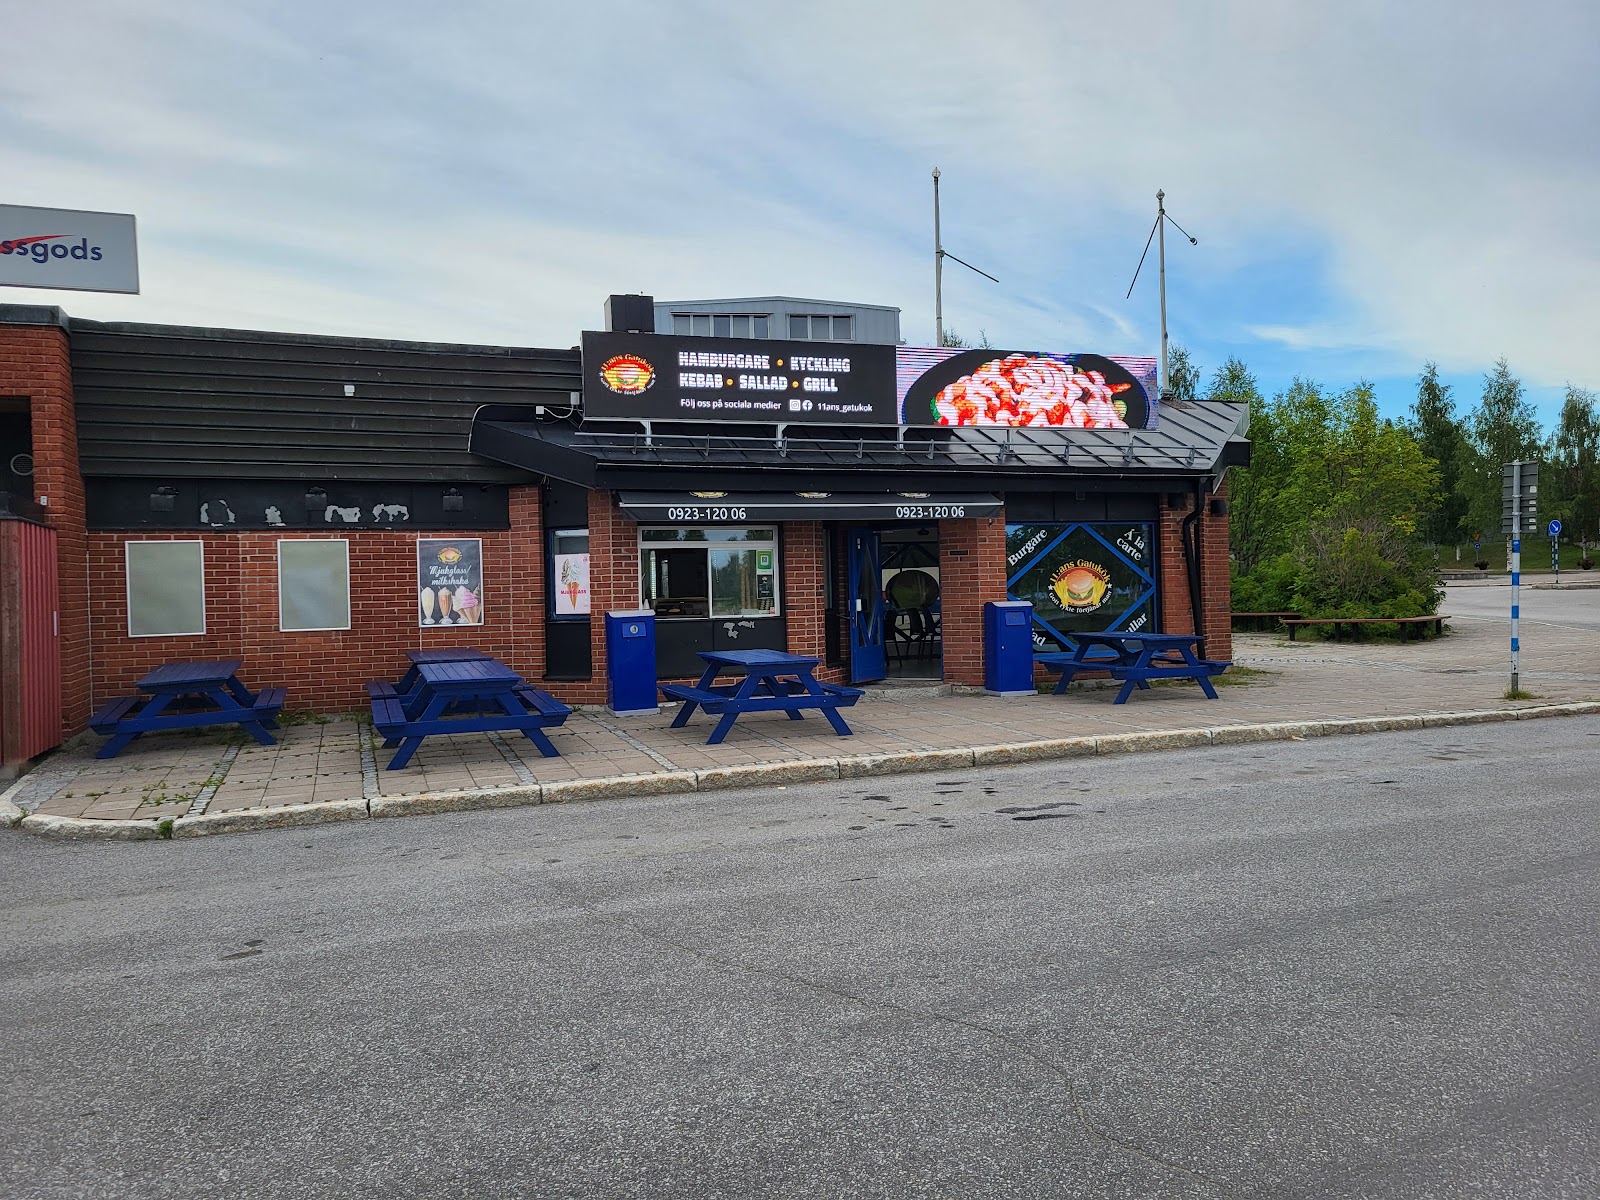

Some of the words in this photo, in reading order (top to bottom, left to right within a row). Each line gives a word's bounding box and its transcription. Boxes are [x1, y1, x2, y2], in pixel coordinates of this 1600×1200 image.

[678, 351, 771, 370] HAMBURGARE
[790, 356, 851, 373] KYCKLING
[679, 372, 724, 388] KEBAB
[739, 374, 788, 391] SALLAD
[803, 376, 839, 392] GRILL
[680, 398, 696, 409] Följ
[697, 400, 711, 408] oss
[712, 399, 723, 410] på
[724, 400, 752, 409] sociala
[753, 401, 782, 410] medier
[668, 507, 728, 520] 0923-120
[730, 507, 747, 520] 06
[895, 506, 949, 518] 0923-120
[951, 506, 965, 518] 06
[1007, 529, 1048, 567] Burgare
[1116, 537, 1142, 561] carte
[1134, 536, 1145, 550] la
[1049, 560, 1075, 583] 11:ans
[1076, 558, 1111, 583] Gatukök
[431, 575, 470, 586] milkshake
[1102, 590, 1112, 604] man
